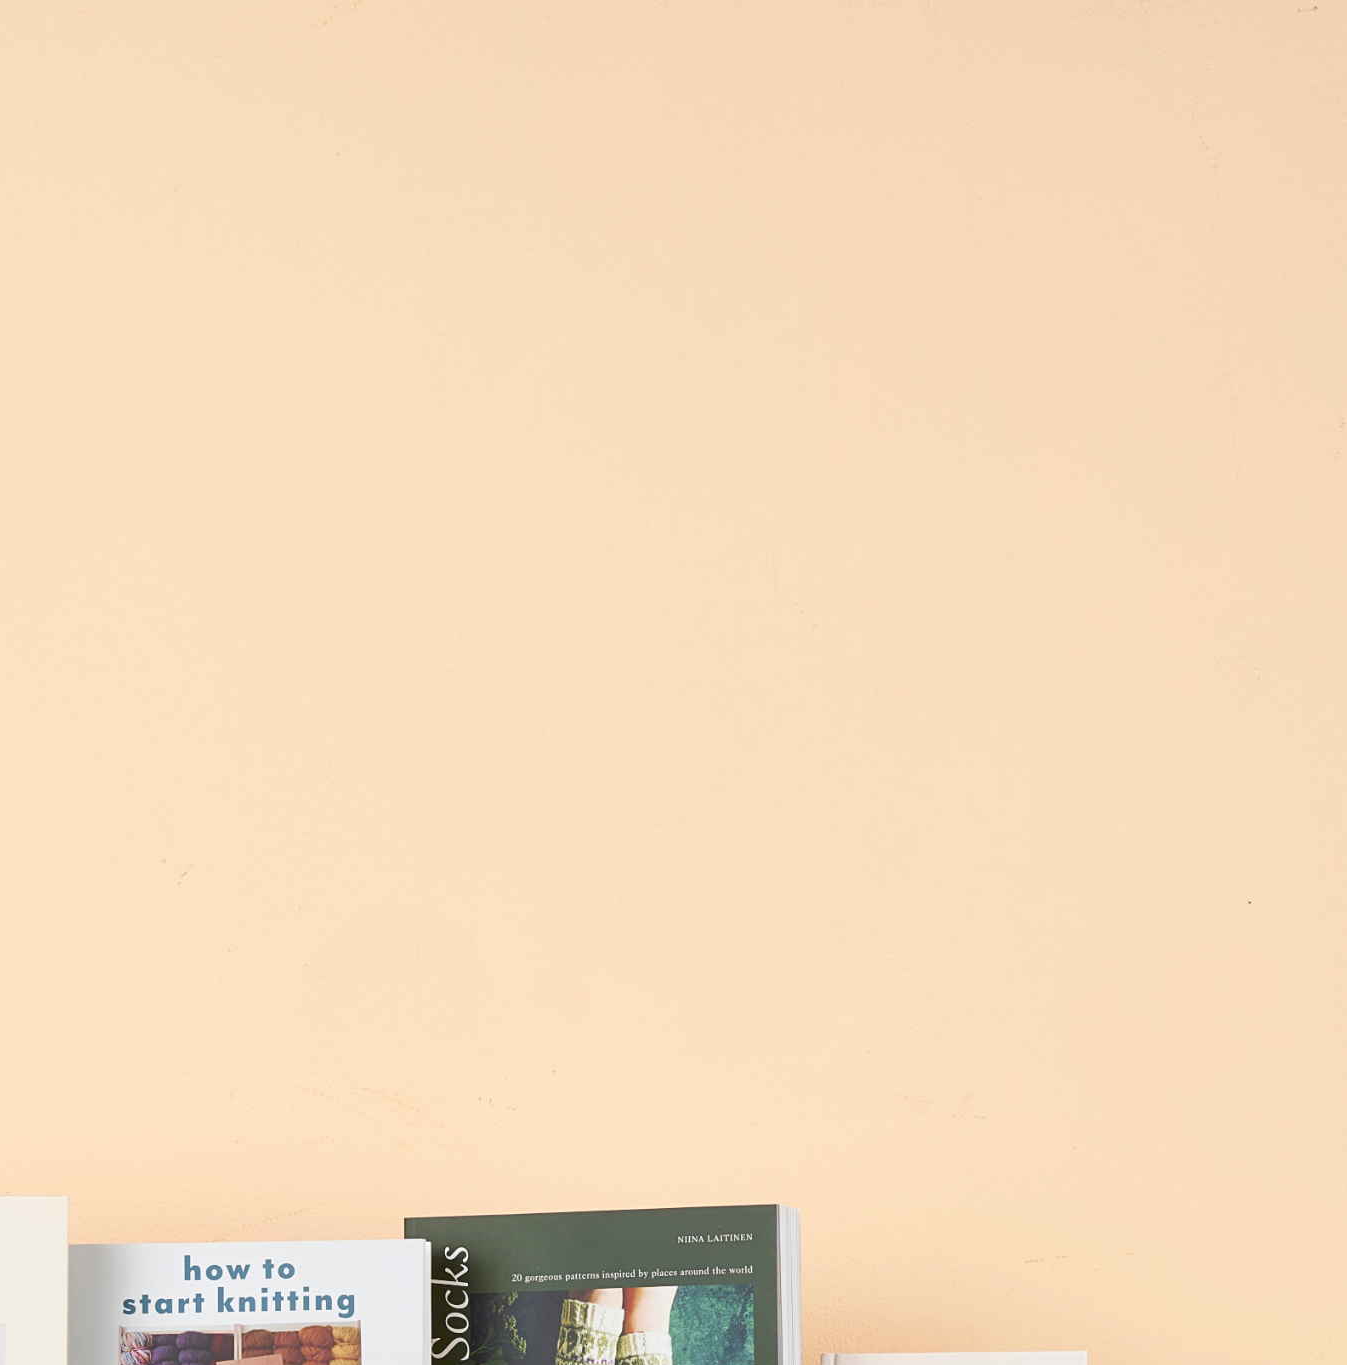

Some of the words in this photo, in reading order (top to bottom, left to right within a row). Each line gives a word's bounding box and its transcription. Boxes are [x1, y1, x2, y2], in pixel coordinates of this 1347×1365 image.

[677, 1235, 705, 1244] NIINA
[708, 1233, 753, 1243] LAITINEN
[185, 1256, 250, 1280] how
[263, 1259, 295, 1280] to
[512, 1274, 522, 1282] 20
[524, 1273, 562, 1284] gorgeous
[565, 1271, 599, 1283] patterns
[602, 1269, 636, 1281] inspired
[639, 1269, 649, 1280] by
[651, 1268, 678, 1279] places
[680, 1267, 710, 1277] around
[712, 1266, 726, 1276] the
[729, 1265, 753, 1275] world
[122, 1294, 205, 1315] start
[218, 1287, 355, 1318] knitting
